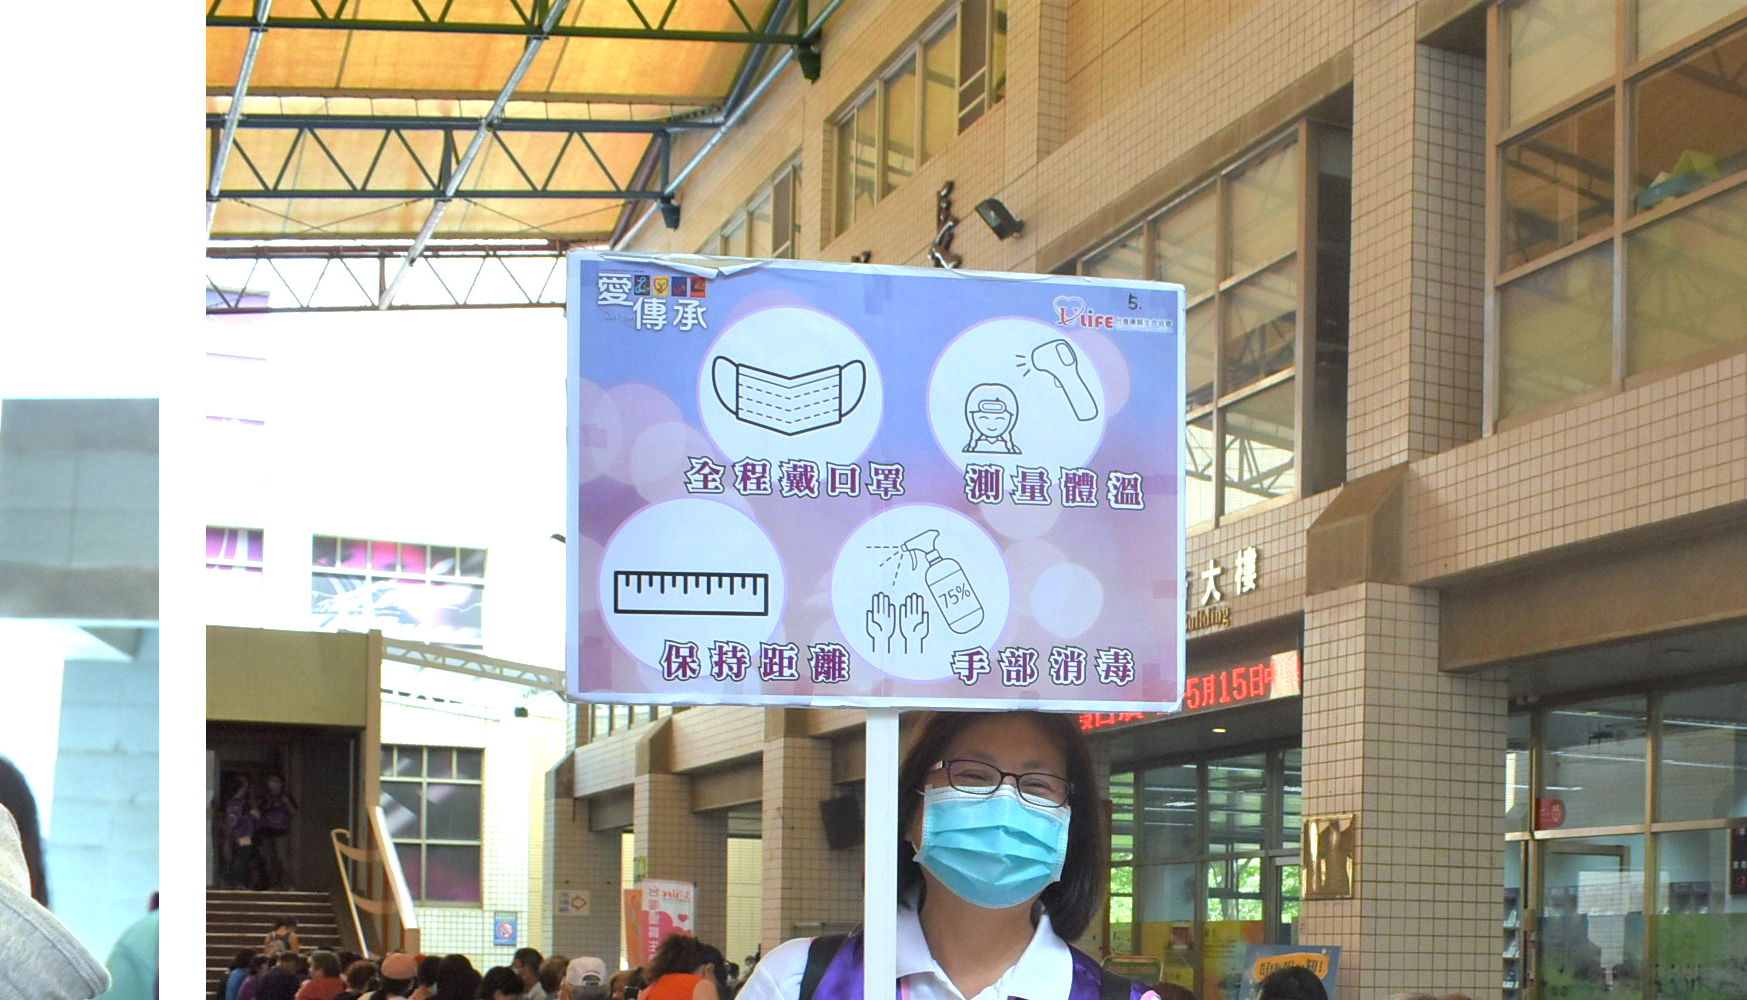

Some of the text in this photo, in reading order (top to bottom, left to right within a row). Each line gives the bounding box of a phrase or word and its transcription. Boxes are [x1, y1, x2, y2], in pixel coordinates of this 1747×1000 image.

[684, 456, 905, 500] 全程戴口罩
[964, 463, 1145, 511] 測量體溫
[938, 582, 970, 608] 75%
[659, 639, 850, 683] 保持距離
[950, 646, 1134, 687] 手部消毒
